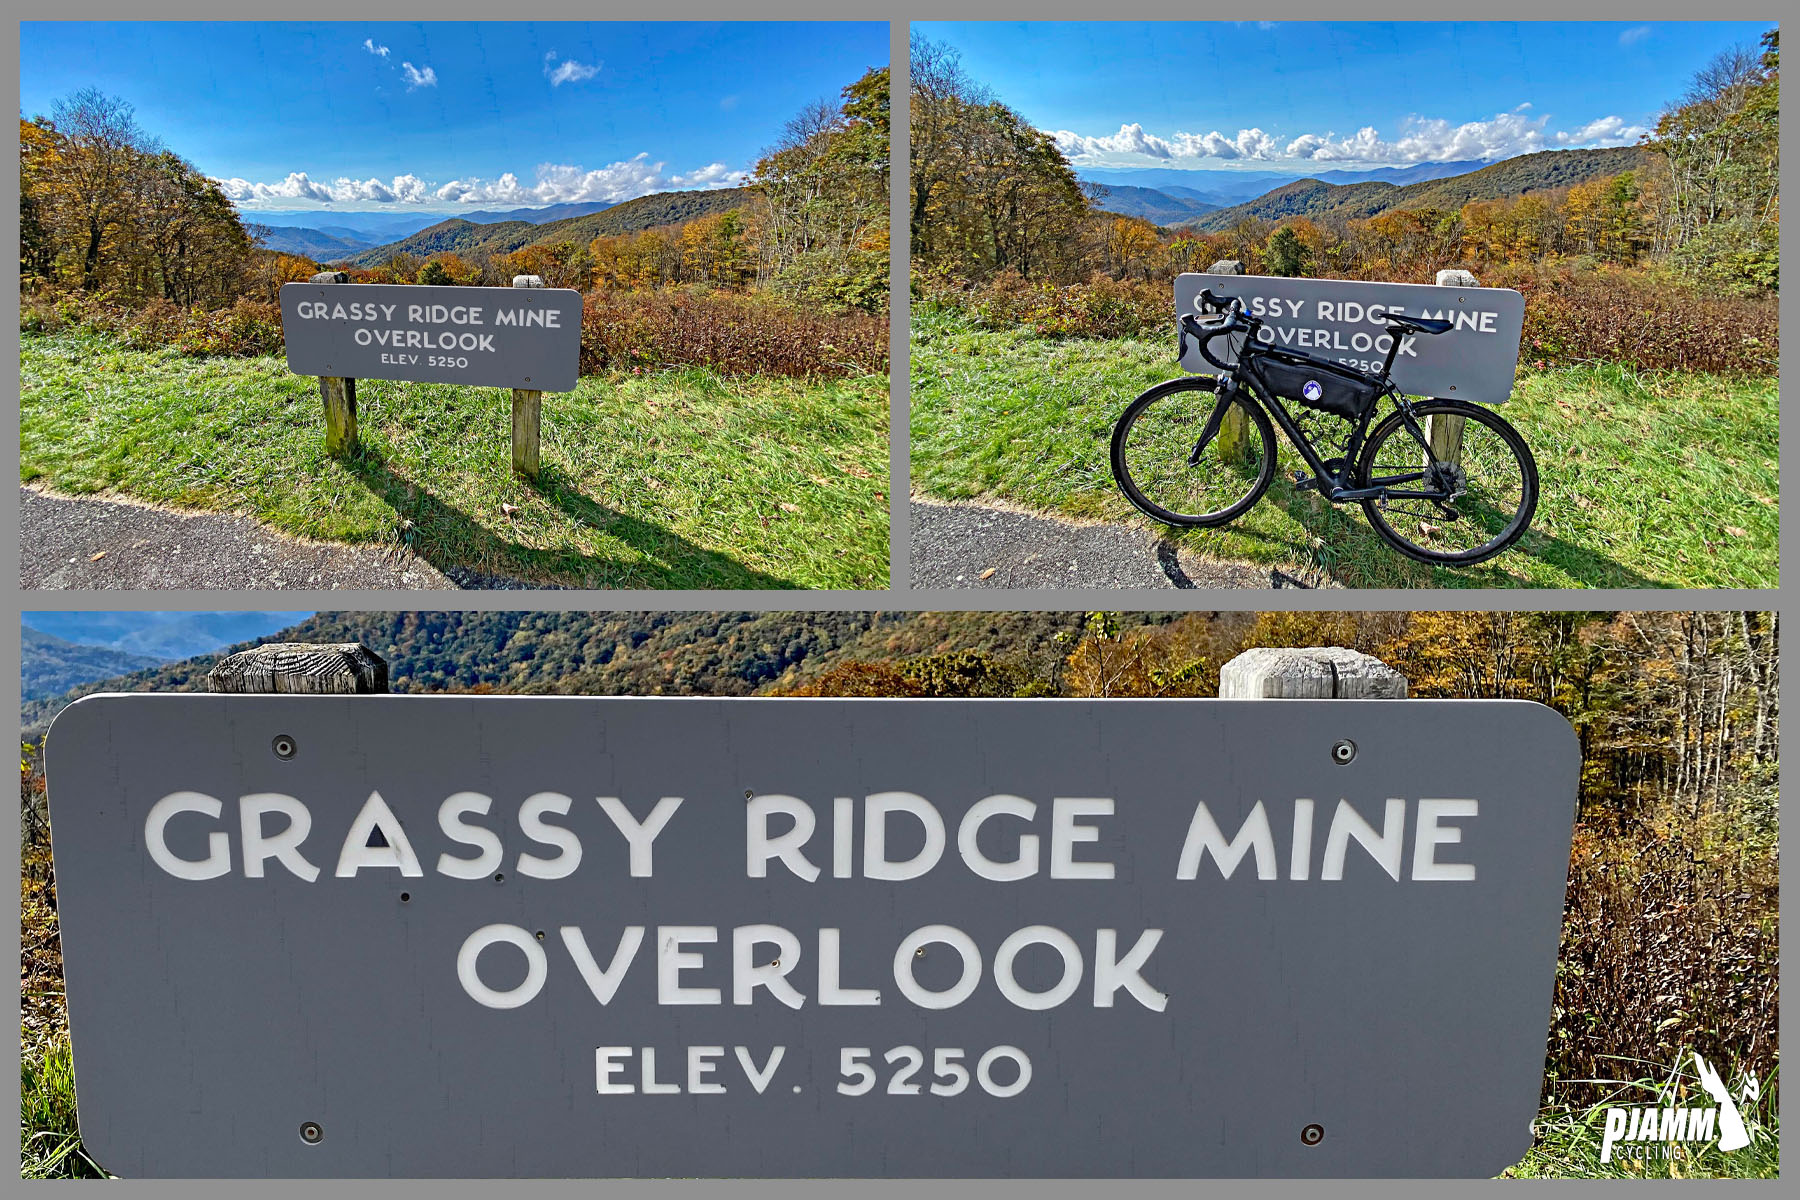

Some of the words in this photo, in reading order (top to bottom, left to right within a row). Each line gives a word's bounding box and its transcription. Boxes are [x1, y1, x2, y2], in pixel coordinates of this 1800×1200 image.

[297, 301, 396, 321] GRASSY
[408, 304, 484, 325] RIDGE
[495, 308, 561, 328] MINE
[354, 328, 496, 352] OVERLOOK
[1256, 324, 1417, 357] OVERLOOK
[381, 353, 422, 365] ELEV.
[428, 355, 468, 369] 5250
[145, 790, 685, 883] GRASSY
[746, 791, 1116, 883] RIDGE
[1176, 797, 1479, 882] MINE
[456, 923, 1169, 1012] OVERLOOK
[595, 1045, 802, 1095] ELEV.
[836, 1044, 1033, 1098] 5250
